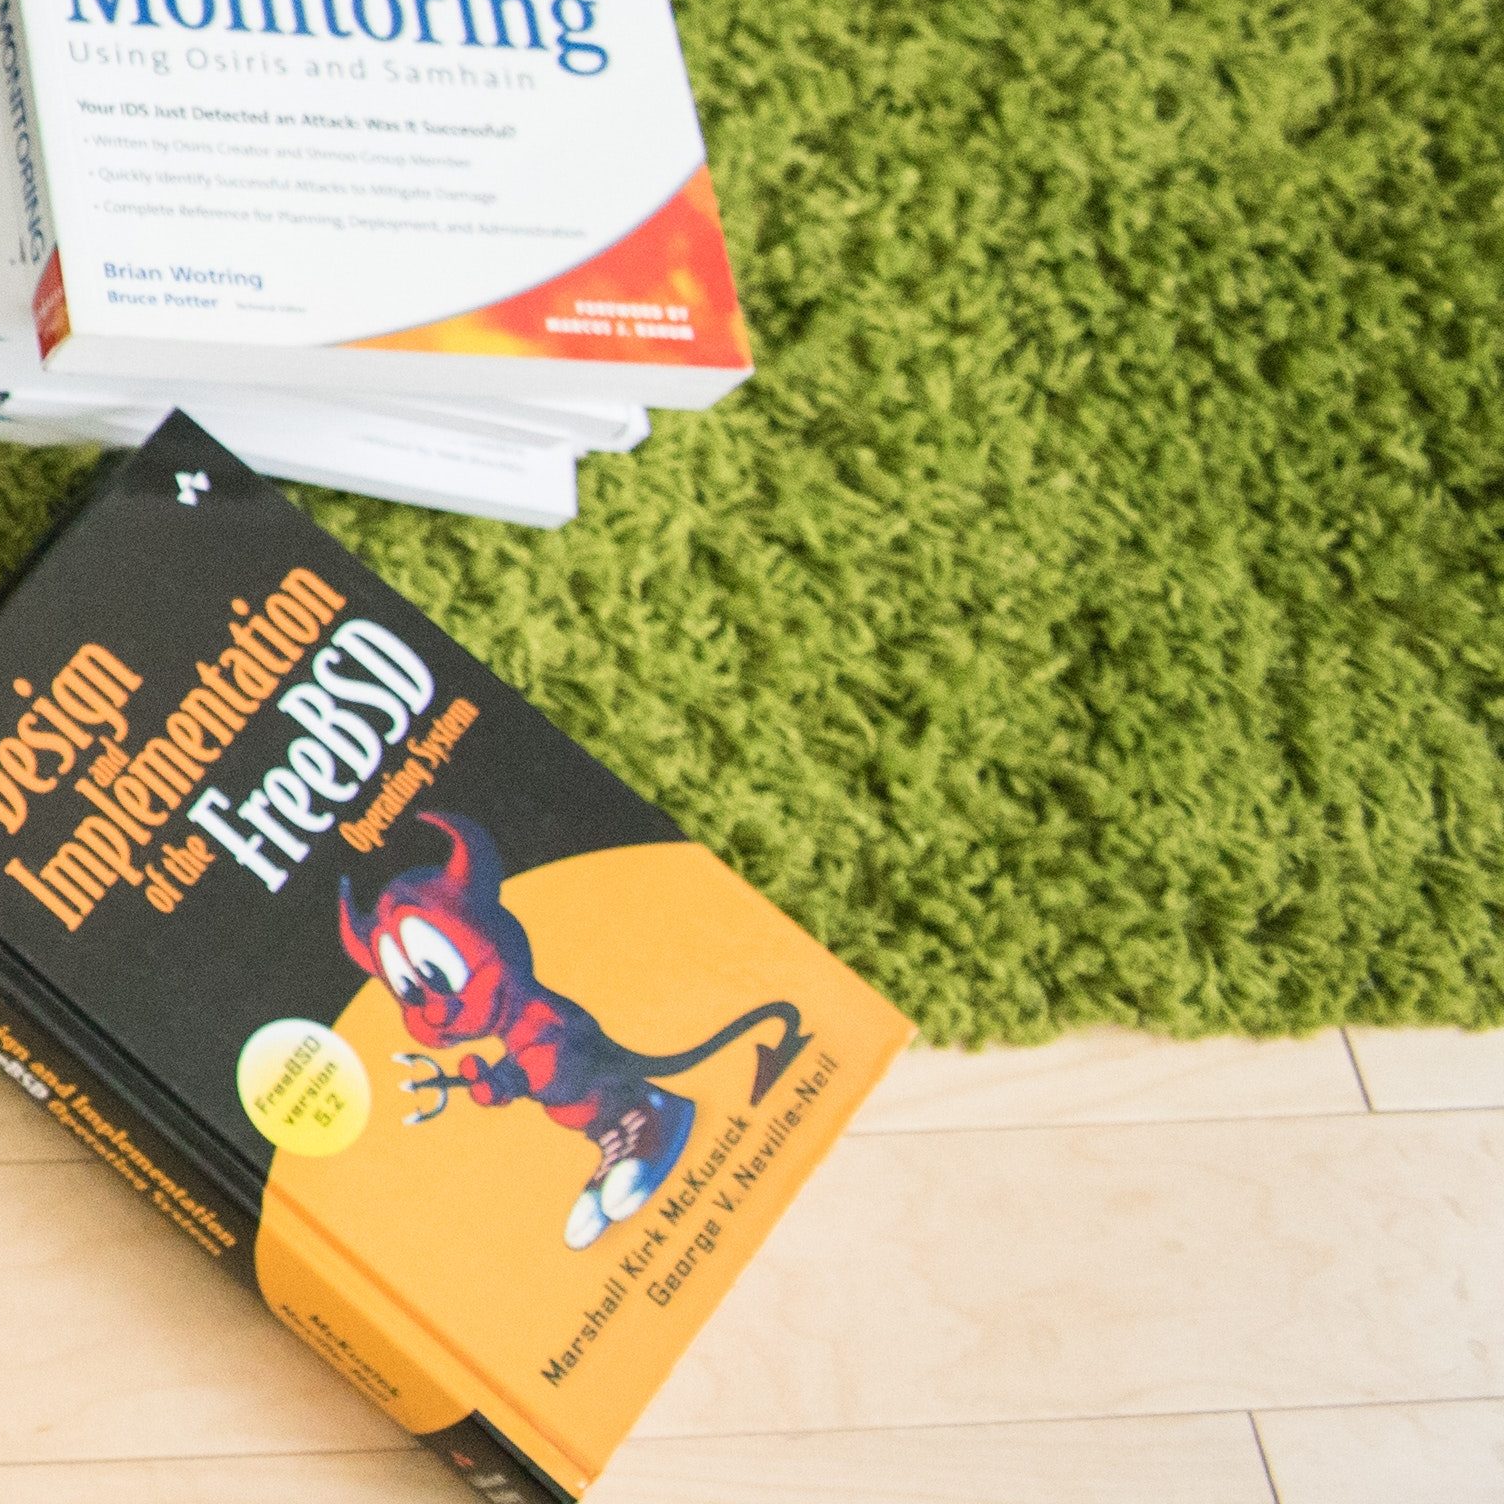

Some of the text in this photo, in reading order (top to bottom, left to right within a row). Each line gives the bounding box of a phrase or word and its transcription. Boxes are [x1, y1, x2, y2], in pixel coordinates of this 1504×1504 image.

[67, 39, 536, 90] Using Osiris and Samhain
[75, 98, 116, 115] Your
[119, 101, 150, 117] IDS
[153, 104, 187, 120] Just
[190, 105, 269, 124] Detected
[274, 113, 296, 126] an
[102, 260, 264, 291] Brian Wotring
[106, 288, 218, 308] Bruce Potter
[5, 568, 345, 930] Implementation
[86, 734, 131, 788] and
[131, 619, 434, 914] of the FreeBSD
[337, 697, 480, 853] Operating System
[252, 1029, 328, 1120] FreeBSD
[281, 1053, 345, 1126] version
[311, 1091, 345, 1128] 5.2
[27, 1061, 77, 1099] and
[70, 1094, 236, 1247] Implementation
[645, 1052, 838, 1308] George V. Neville-Neil
[539, 1115, 750, 1388] Marshall Kirk McKusick
